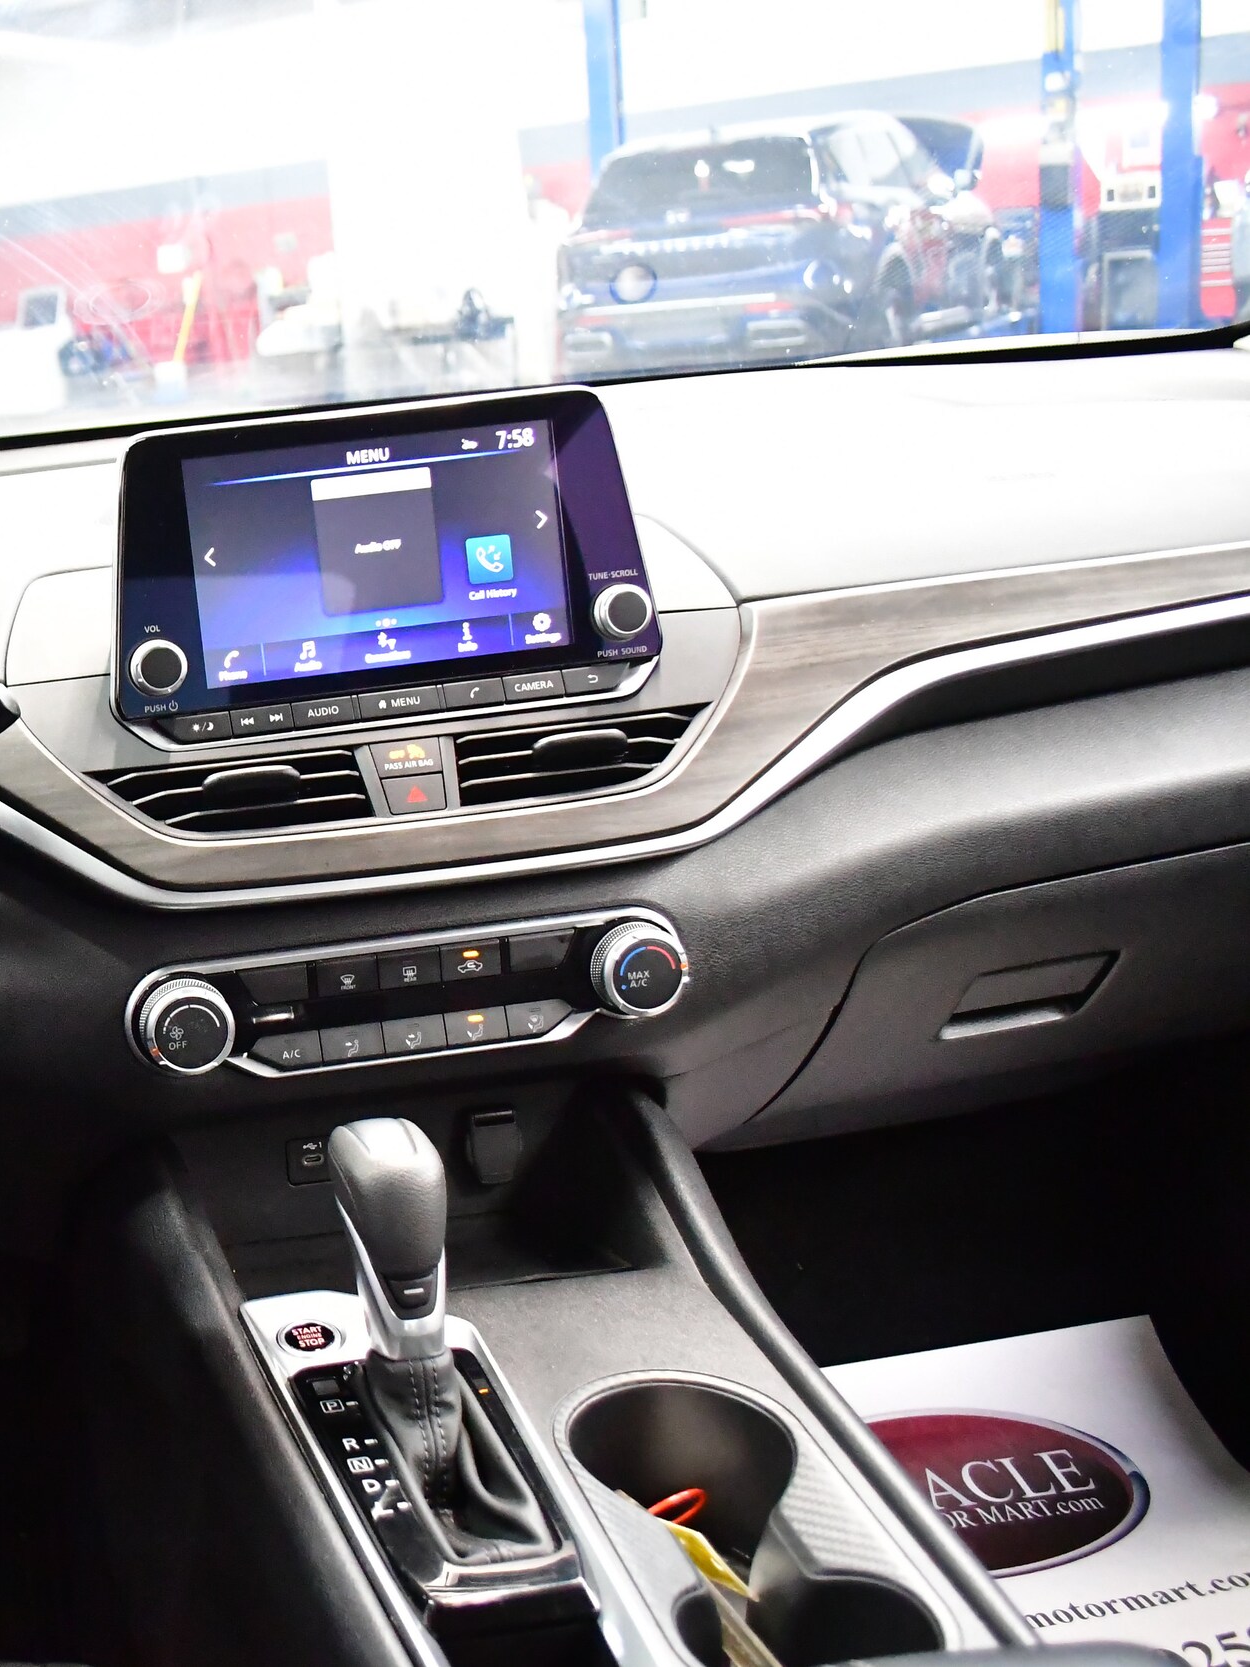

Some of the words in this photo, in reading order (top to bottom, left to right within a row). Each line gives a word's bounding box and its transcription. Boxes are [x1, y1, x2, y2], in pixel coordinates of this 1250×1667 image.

[495, 427, 535, 450] 7:58
[346, 447, 390, 465] MENU
[355, 543, 382, 554] Audio
[383, 538, 402, 551] OFF
[468, 589, 485, 601] Call
[486, 587, 517, 599] History
[144, 624, 161, 634] VOL
[597, 648, 618, 658] PUSH
[621, 645, 648, 655] SOUND
[514, 680, 554, 693] CAMERA
[144, 703, 167, 713] PUSH
[391, 696, 421, 708] MENU
[307, 705, 340, 718] AUDIO
[384, 762, 403, 771] PASS
[404, 760, 417, 769] AIR
[418, 758, 434, 767] BAG
[627, 970, 650, 981] MAX
[340, 983, 357, 991] FRONT
[629, 978, 648, 988] A/C
[168, 1041, 187, 1051] OFF
[282, 1048, 302, 1060] A/C
[318, 1141, 323, 1149] 1
[291, 1325, 322, 1336] START
[296, 1332, 323, 1341] ENGINE
[299, 1337, 326, 1348] STOP
[325, 1401, 339, 1411] P
[342, 1437, 360, 1451] R
[352, 1459, 367, 1470] N
[925, 1448, 1096, 1510] ACLE
[361, 1478, 381, 1494] D
[975, 1496, 1104, 1526] MART.com
[1023, 1571, 1250, 1630] motormart.co
[1181, 1625, 1250, 1667] 25
